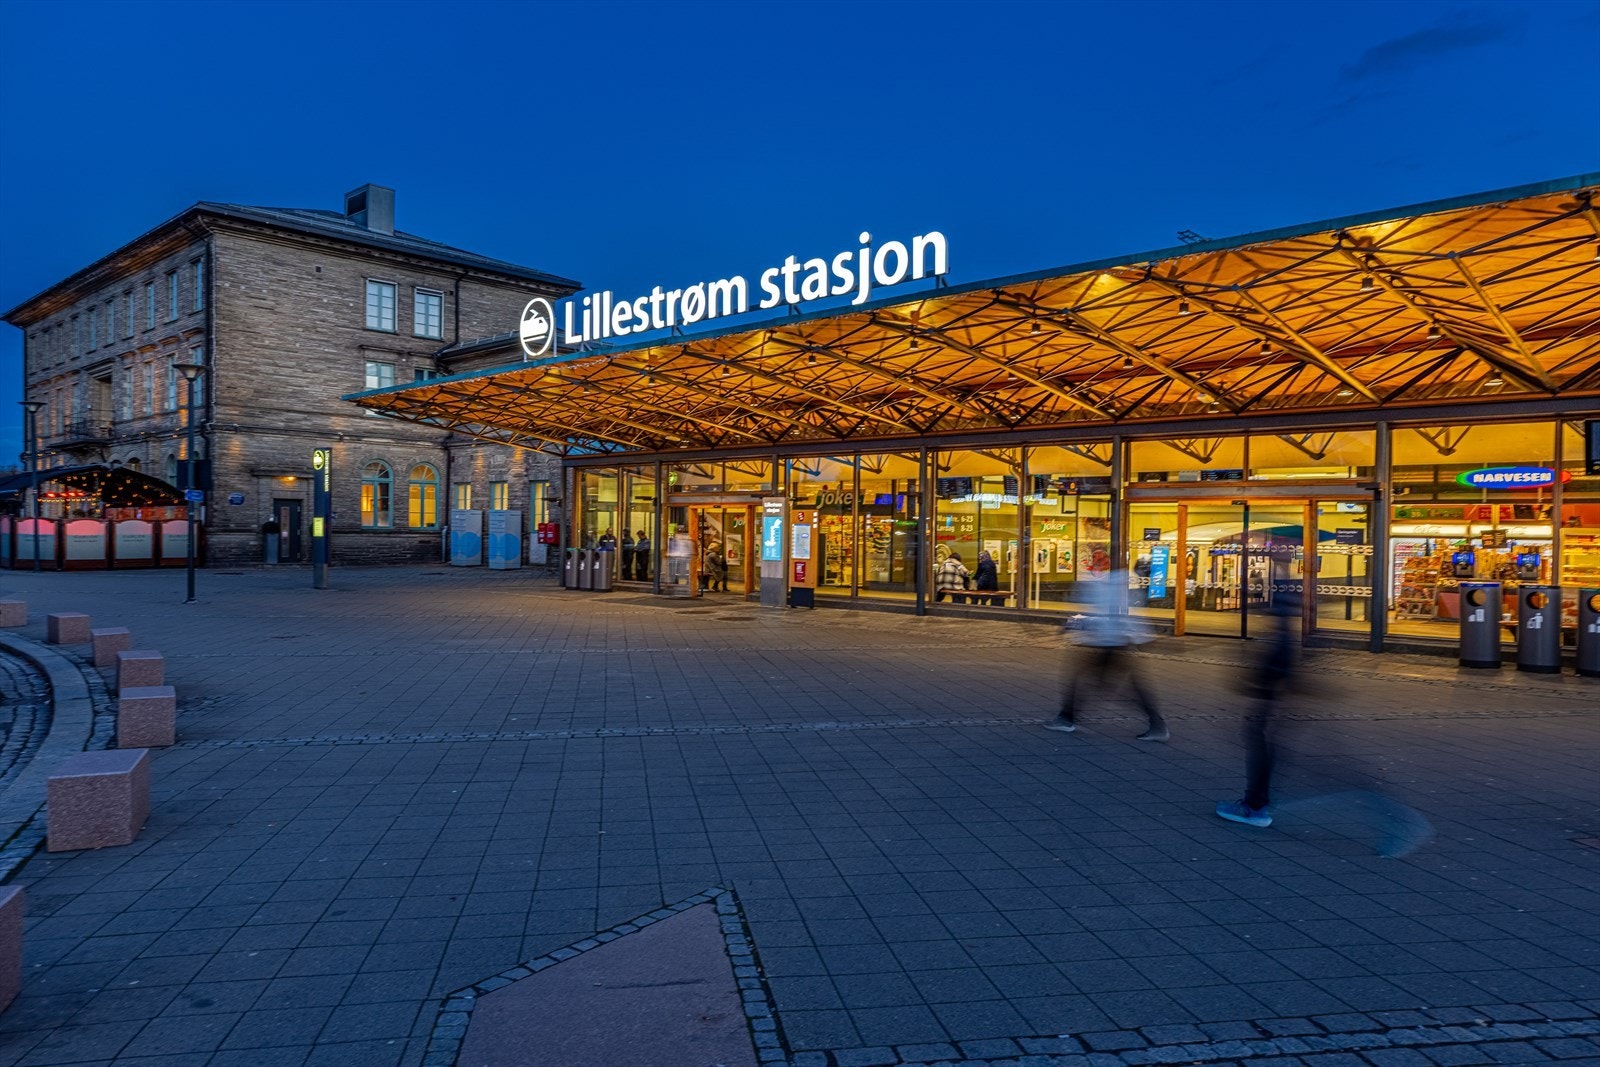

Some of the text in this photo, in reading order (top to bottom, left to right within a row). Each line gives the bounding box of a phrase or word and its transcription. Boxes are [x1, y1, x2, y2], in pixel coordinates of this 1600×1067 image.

[565, 231, 949, 344] Lillestrøm stasjon
[1473, 472, 1551, 483] NARVESEN
[815, 484, 853, 509] joke
[1041, 518, 1065, 533] joker
